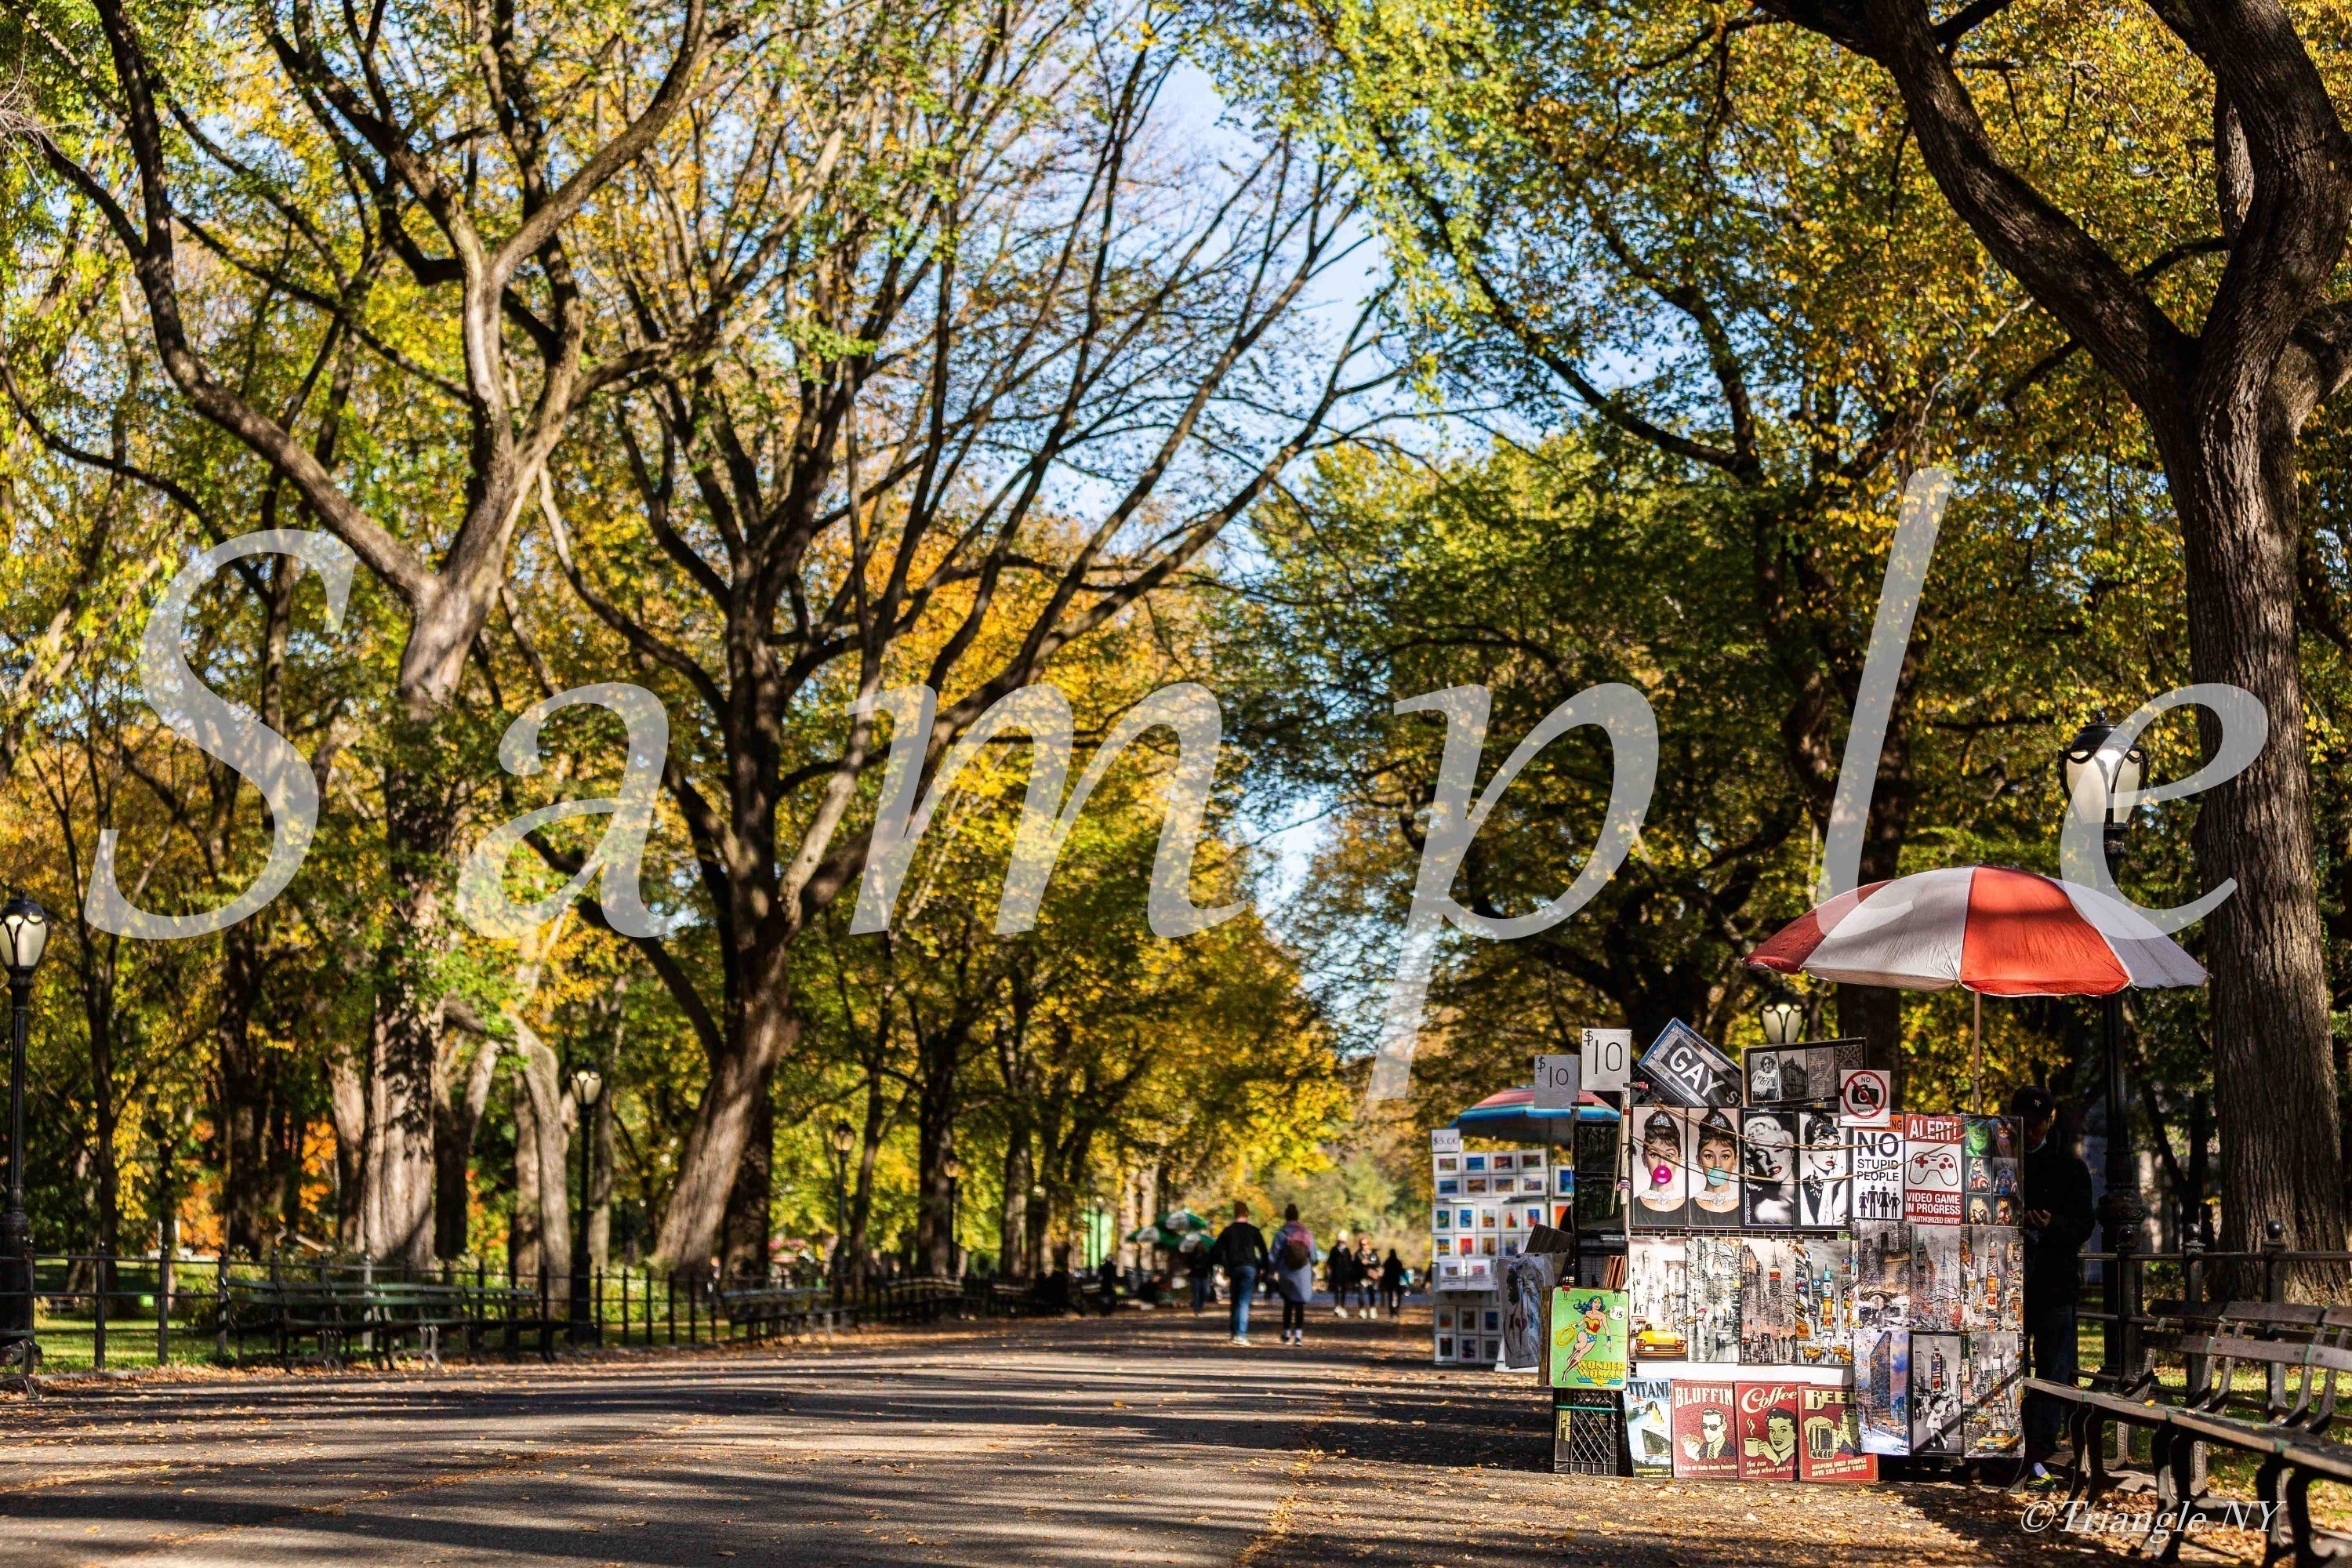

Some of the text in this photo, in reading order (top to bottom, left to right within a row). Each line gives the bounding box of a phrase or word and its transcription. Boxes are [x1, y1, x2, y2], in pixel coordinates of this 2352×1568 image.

[1670, 1047, 1725, 1098] GAY
[1909, 1120, 1957, 1141] ALERT!
[1857, 1131, 1899, 1157] NO
[1857, 1159, 1898, 1170] STUPID
[1857, 1171, 1899, 1181] PEOPLE
[1906, 1192, 1960, 1204] VIDEO GAME
[1906, 1203, 1961, 1214] IN PROGRESS
[1907, 1215, 1944, 1224] UNAUTHORIZED
[1577, 1360, 1625, 1370] WONDER
[1577, 1369, 1623, 1379] WOMAN
[1628, 1381, 1670, 1398] TITANI
[1675, 1386, 1733, 1409] BLUFFIN
[1741, 1386, 1797, 1413] Coffee
[1777, 1465, 1792, 1473] you're
